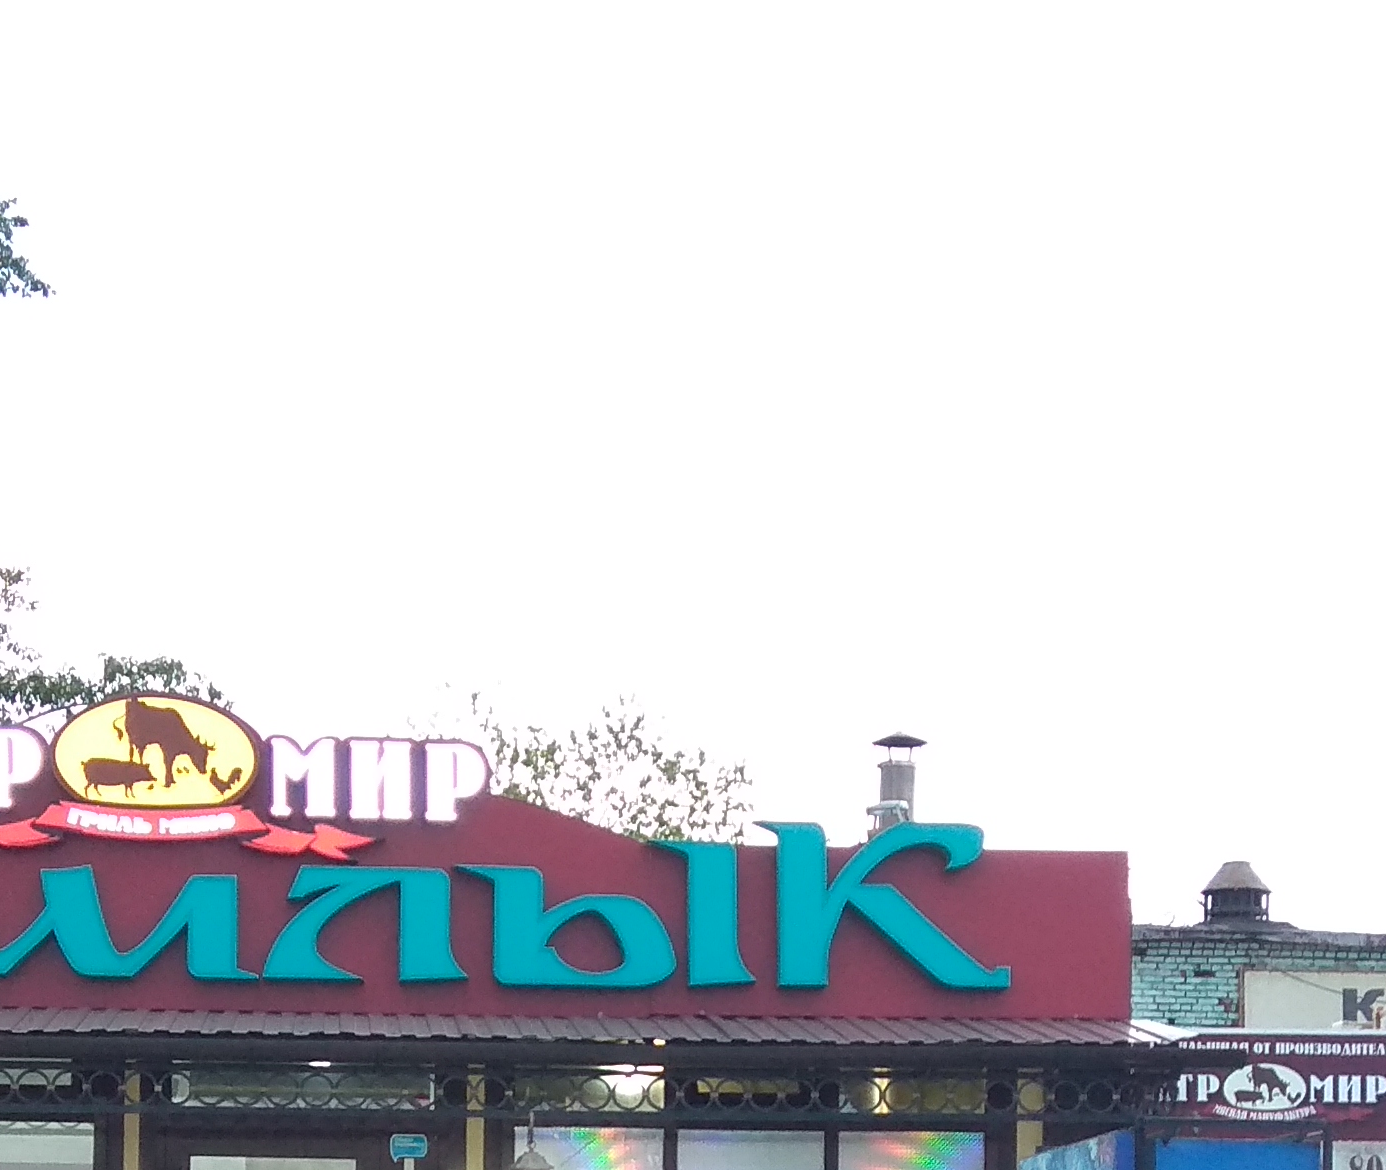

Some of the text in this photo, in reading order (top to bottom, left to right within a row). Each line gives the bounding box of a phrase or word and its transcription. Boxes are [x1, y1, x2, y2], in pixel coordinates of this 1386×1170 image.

[268, 735, 490, 822] МИР
[1253, 1041, 1271, 1055] ОТ
[1158, 1072, 1221, 1103] ГР
